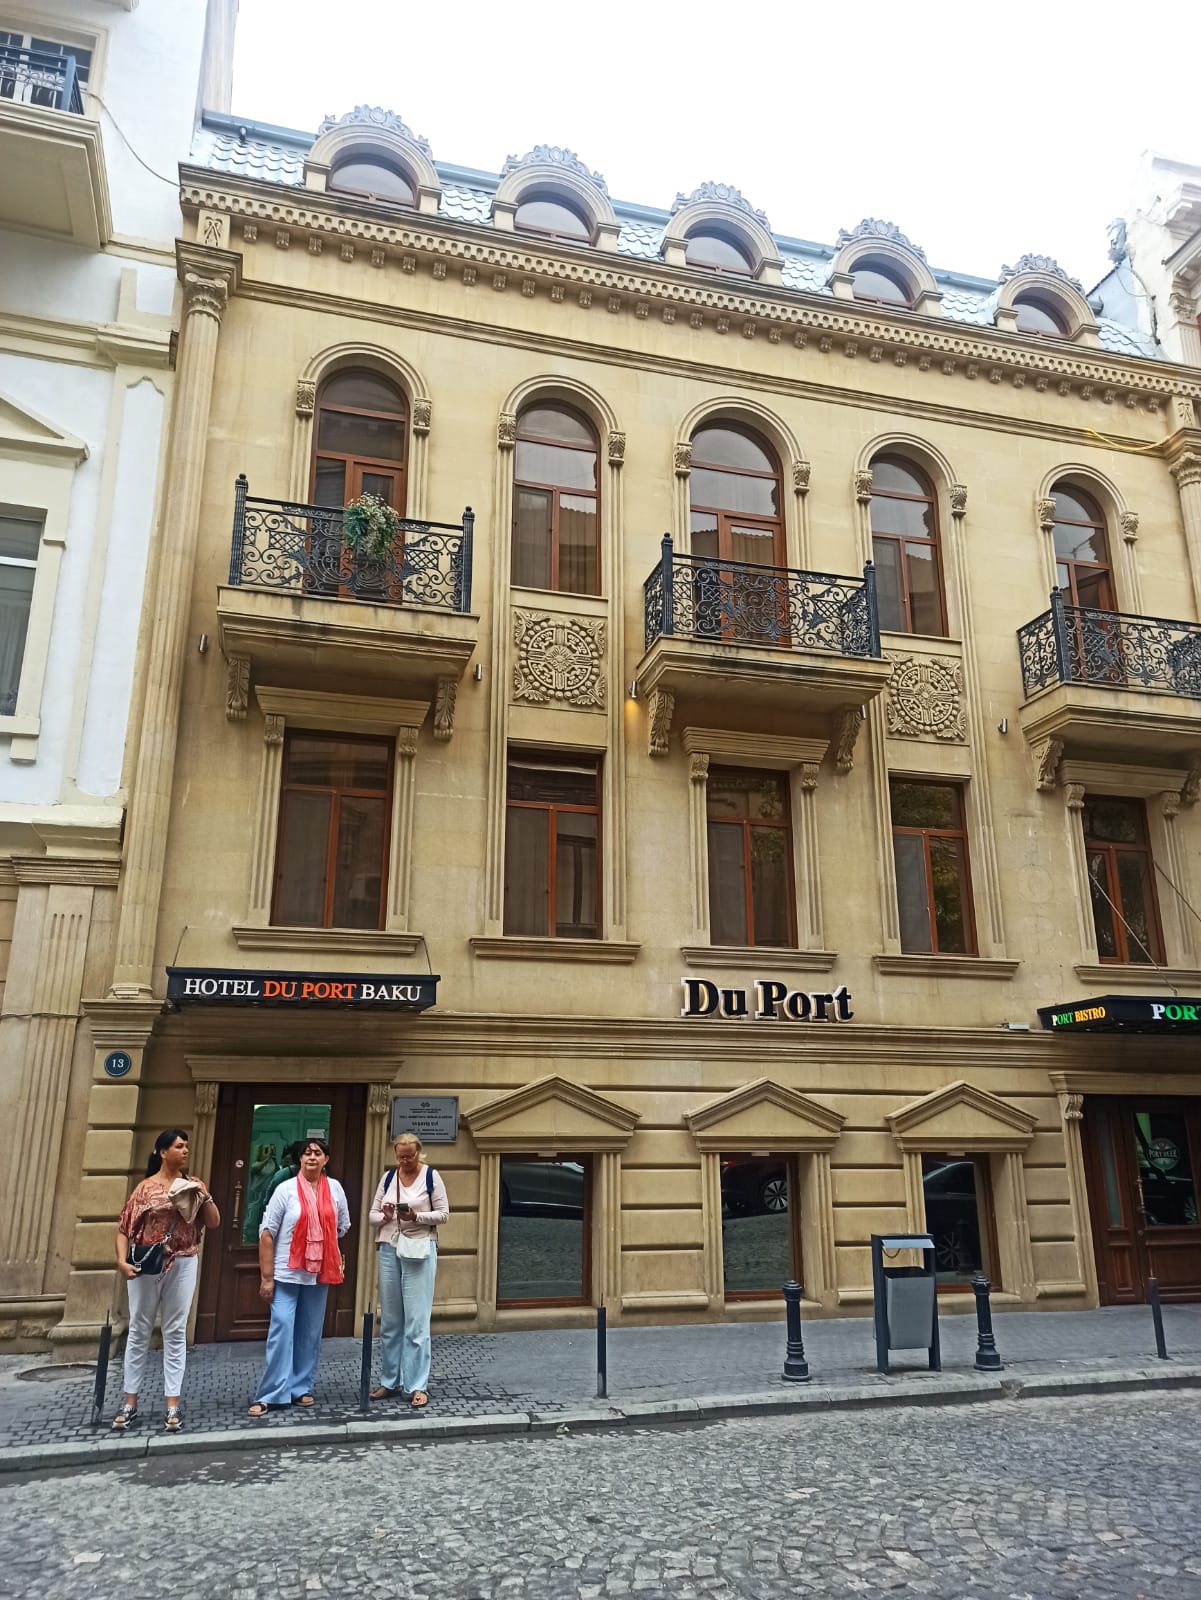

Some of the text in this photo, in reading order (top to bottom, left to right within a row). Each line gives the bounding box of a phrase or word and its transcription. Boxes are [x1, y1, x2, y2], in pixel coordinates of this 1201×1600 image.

[183, 978, 422, 1001] HOTEL DU PORT BAKU
[681, 977, 854, 1023] Du Port
[1051, 1006, 1106, 1026] PORT BISTRO
[112, 1058, 124, 1068] 13
